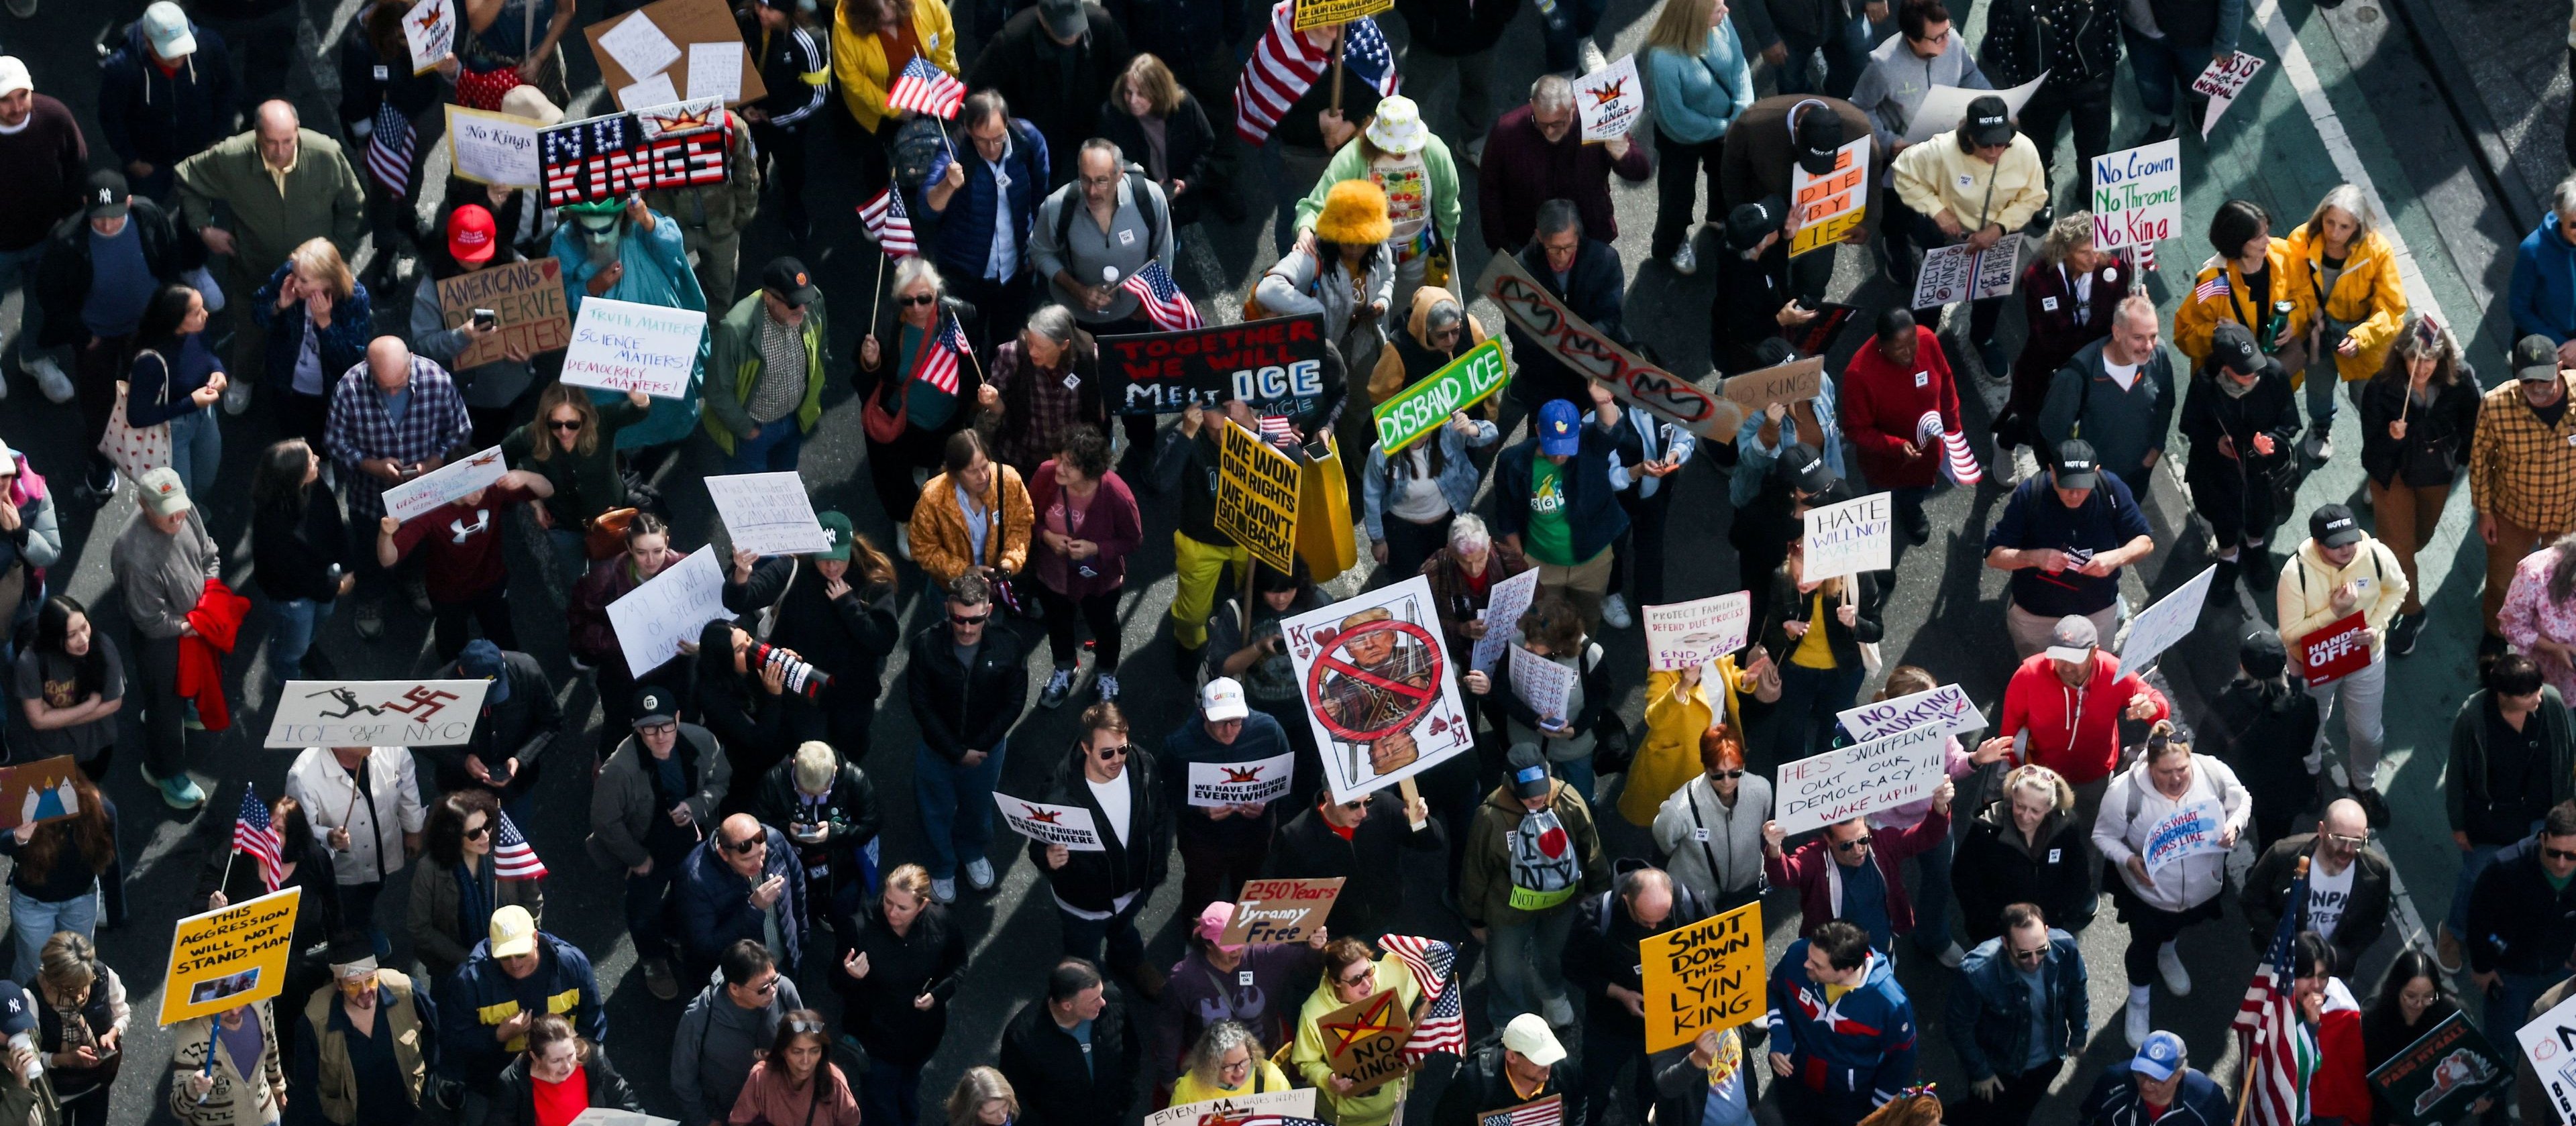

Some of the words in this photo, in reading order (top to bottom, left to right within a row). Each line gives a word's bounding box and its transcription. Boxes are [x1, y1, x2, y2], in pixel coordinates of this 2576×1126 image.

[1310, 4, 1326, 15] OUR
[1327, 0, 1377, 12] COMMUNIT
[2194, 79, 2233, 99] NORMAL
[1597, 105, 1629, 127] KINGS
[1604, 99, 1619, 112] NO
[466, 125, 486, 138] No
[490, 130, 531, 150] Kings
[544, 117, 623, 164] NO
[545, 132, 722, 205] KINGS
[2097, 160, 2121, 185] No
[2127, 151, 2174, 182] Crown
[1801, 169, 1858, 205] DIE
[2096, 189, 2122, 214] No
[2120, 182, 2178, 209] Throne
[1809, 194, 1845, 222] BY
[1789, 213, 1861, 254] LIES
[2094, 214, 2121, 249] No
[2127, 209, 2167, 245] King
[1918, 250, 1945, 307] REJECTING
[1939, 257, 1960, 288] KINGS
[445, 266, 541, 311] AMERICANS
[588, 308, 631, 325] TRUTH
[638, 318, 698, 336] MATTERS
[459, 315, 568, 364] BETTER
[576, 329, 642, 351] SCIENCE
[1114, 319, 1318, 361] TOGETHER
[566, 359, 646, 379] DEMOCRACY
[613, 349, 690, 372] MATTERS!
[1124, 359, 1185, 381] WE
[1208, 346, 1296, 370] WILL
[599, 376, 678, 393] MATTERS!
[1232, 359, 1323, 400] ICE
[1766, 371, 1817, 399] KINGS
[1265, 397, 1313, 418] ICE
[1378, 376, 1462, 448] DISBAND
[1470, 349, 1504, 397] ICE
[1226, 425, 1254, 459] WE
[1252, 438, 1296, 493] WON
[1800, 463, 1815, 475] NOT
[2064, 460, 2080, 468] NOT
[2080, 460, 2090, 469] OK
[1223, 453, 1248, 484] OUR
[1249, 466, 1295, 513] RIGHTS
[1221, 477, 1244, 506] WE
[1244, 489, 1293, 536] WON'T
[1817, 498, 1887, 534] HATE
[1218, 501, 1236, 526] GO
[1247, 518, 1291, 561] BACK!
[1812, 526, 1851, 550] WILL
[1856, 520, 1891, 540] NOT
[2326, 520, 2341, 530] NOT
[2341, 517, 2352, 526] OK
[1814, 540, 1866, 560] MAKE
[1867, 537, 1890, 550] US
[624, 602, 651, 624] MY
[659, 563, 713, 601] POWER
[647, 617, 663, 636] OF
[669, 593, 711, 624] SPEECH
[1652, 608, 1696, 620] PROTECT
[1702, 598, 1741, 615] FAMILIES
[1652, 620, 1684, 632] DEFEND
[1688, 618, 1707, 630] DUE
[1711, 607, 1745, 625] PROCESS
[1287, 624, 1310, 648] K
[1661, 649, 1697, 659] END
[2310, 637, 2361, 668] OFF
[1858, 705, 1896, 726] NO
[404, 721, 469, 741] NYC
[1450, 724, 1469, 748] K
[1784, 755, 1831, 784] HE'S
[1845, 725, 1939, 765] SNUFFING
[1194, 783, 1212, 792] WE
[1214, 782, 1244, 793] HAVE
[1246, 775, 1287, 791] FRIENDS
[1801, 772, 1843, 795] OUT
[1868, 754, 1911, 773] OUR
[1195, 782, 1287, 803] EVERYWHERE
[1784, 765, 1915, 815] DEMOCRACY
[1819, 795, 1872, 823] WAKE
[1878, 783, 1919, 805] UP!!!
[1008, 813, 1024, 826] WE
[1024, 818, 1049, 832] HAVE
[1050, 823, 1092, 837] FRIENDS
[1012, 820, 1095, 846] EVERYWHERE
[2161, 822, 2169, 832] IS
[2171, 811, 2198, 828] WHAT
[1519, 831, 1537, 861] I
[2149, 820, 2200, 854] DEMOCRACY
[2151, 838, 2178, 866] LOOKS
[2179, 830, 2206, 849] LIKE
[1516, 858, 1572, 891] NY
[1246, 883, 1291, 901] 250
[1291, 882, 1338, 901] Years
[1511, 889, 1534, 907] NOT
[179, 907, 290, 948] AGGRESSION
[208, 906, 252, 925] THIS
[1238, 900, 1311, 928] Tyranny
[190, 940, 233, 958] WILL
[243, 924, 276, 942] NOT
[252, 931, 292, 956] MAN
[1246, 920, 1301, 942] Free
[1668, 911, 1747, 957] SHUT
[1672, 934, 1750, 974] DOWN
[1676, 958, 1727, 984] THIS
[1670, 964, 1752, 1013] LYIN'
[8, 998, 21, 1014] NY
[1674, 991, 1754, 1036] KING
[1352, 1035, 1395, 1064] NO
[1154, 1106, 1197, 1126] EVEN
[1243, 1096, 1269, 1107] HATES
